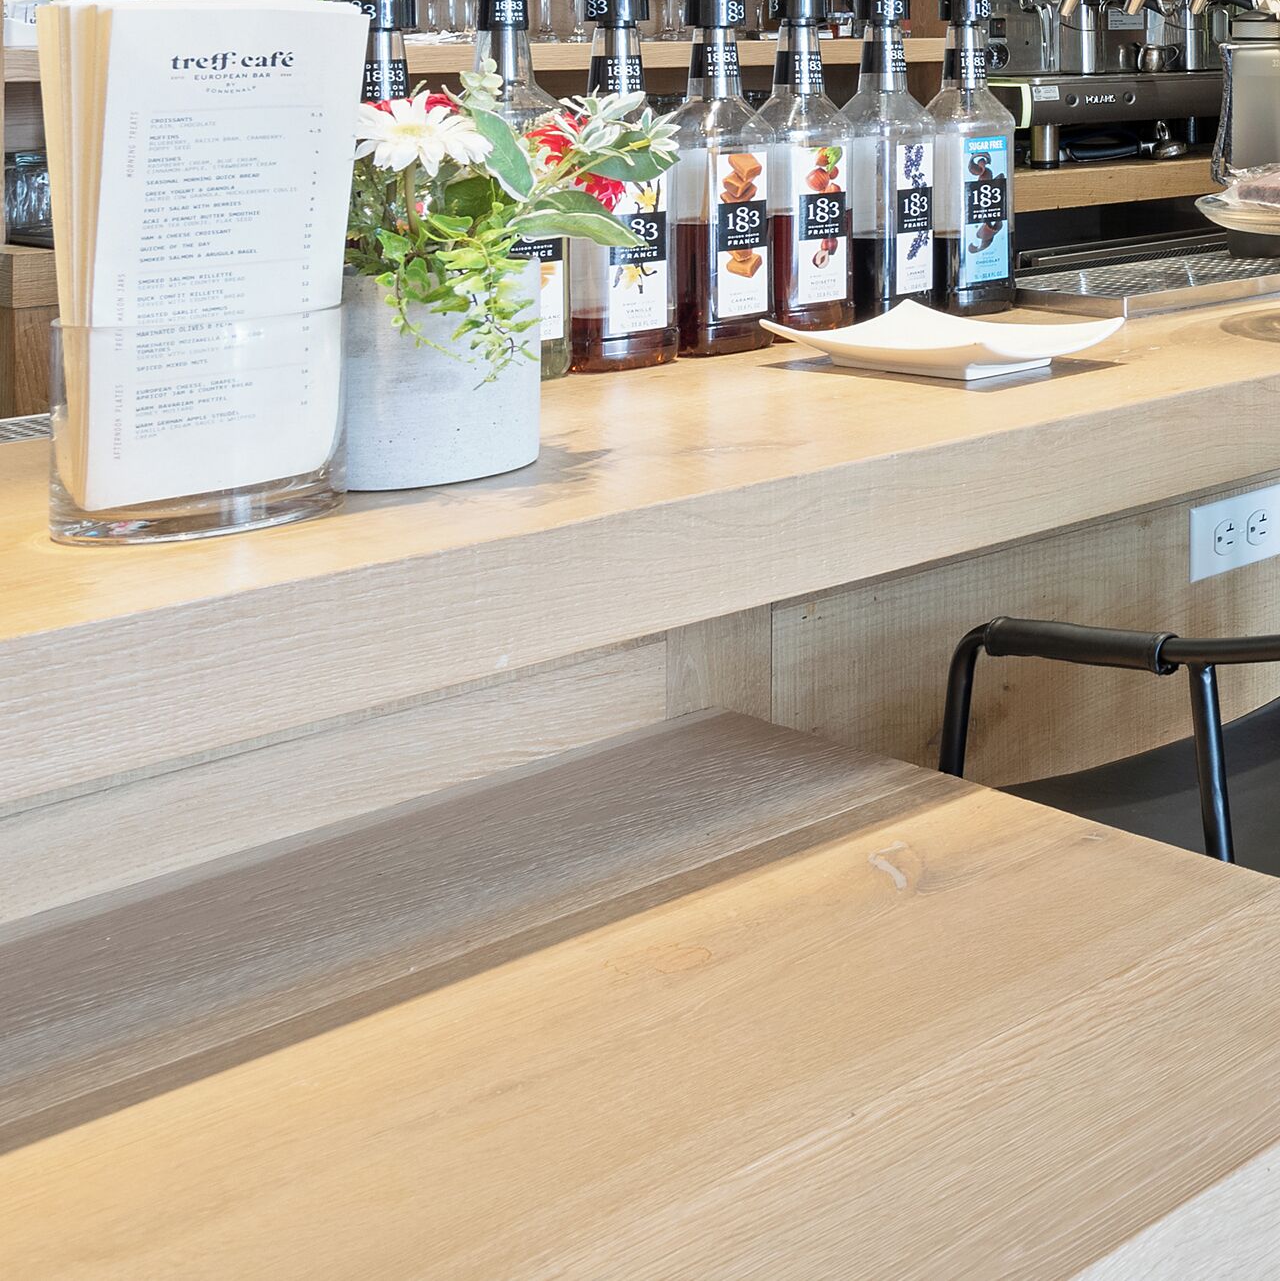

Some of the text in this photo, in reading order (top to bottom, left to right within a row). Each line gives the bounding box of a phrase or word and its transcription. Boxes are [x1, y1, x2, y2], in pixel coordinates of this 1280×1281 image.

[495, 0, 523, 11] 1883
[171, 51, 294, 71] treff café
[707, 52, 737, 63] 1883
[960, 57, 985, 67] 1883
[794, 60, 822, 71] 1883
[194, 73, 248, 81] EUROPEAN
[365, 69, 404, 83] 1883
[607, 65, 641, 78] 1883
[1085, 94, 1116, 105] POLARIS
[968, 139, 1004, 152] SUGAR FREE
[972, 184, 1002, 208] 1883
[807, 197, 840, 223] 1883
[903, 192, 928, 217] 1883
[727, 206, 760, 233] 1883
[973, 211, 1001, 220] FRANCE
[903, 221, 928, 229] FRANCE
[807, 227, 839, 236] FRANCE
[727, 237, 760, 246] FRANCE
[620, 250, 658, 260] FRANCE
[975, 257, 1001, 265] CHOCOLAT
[626, 307, 652, 315] VANILLE
